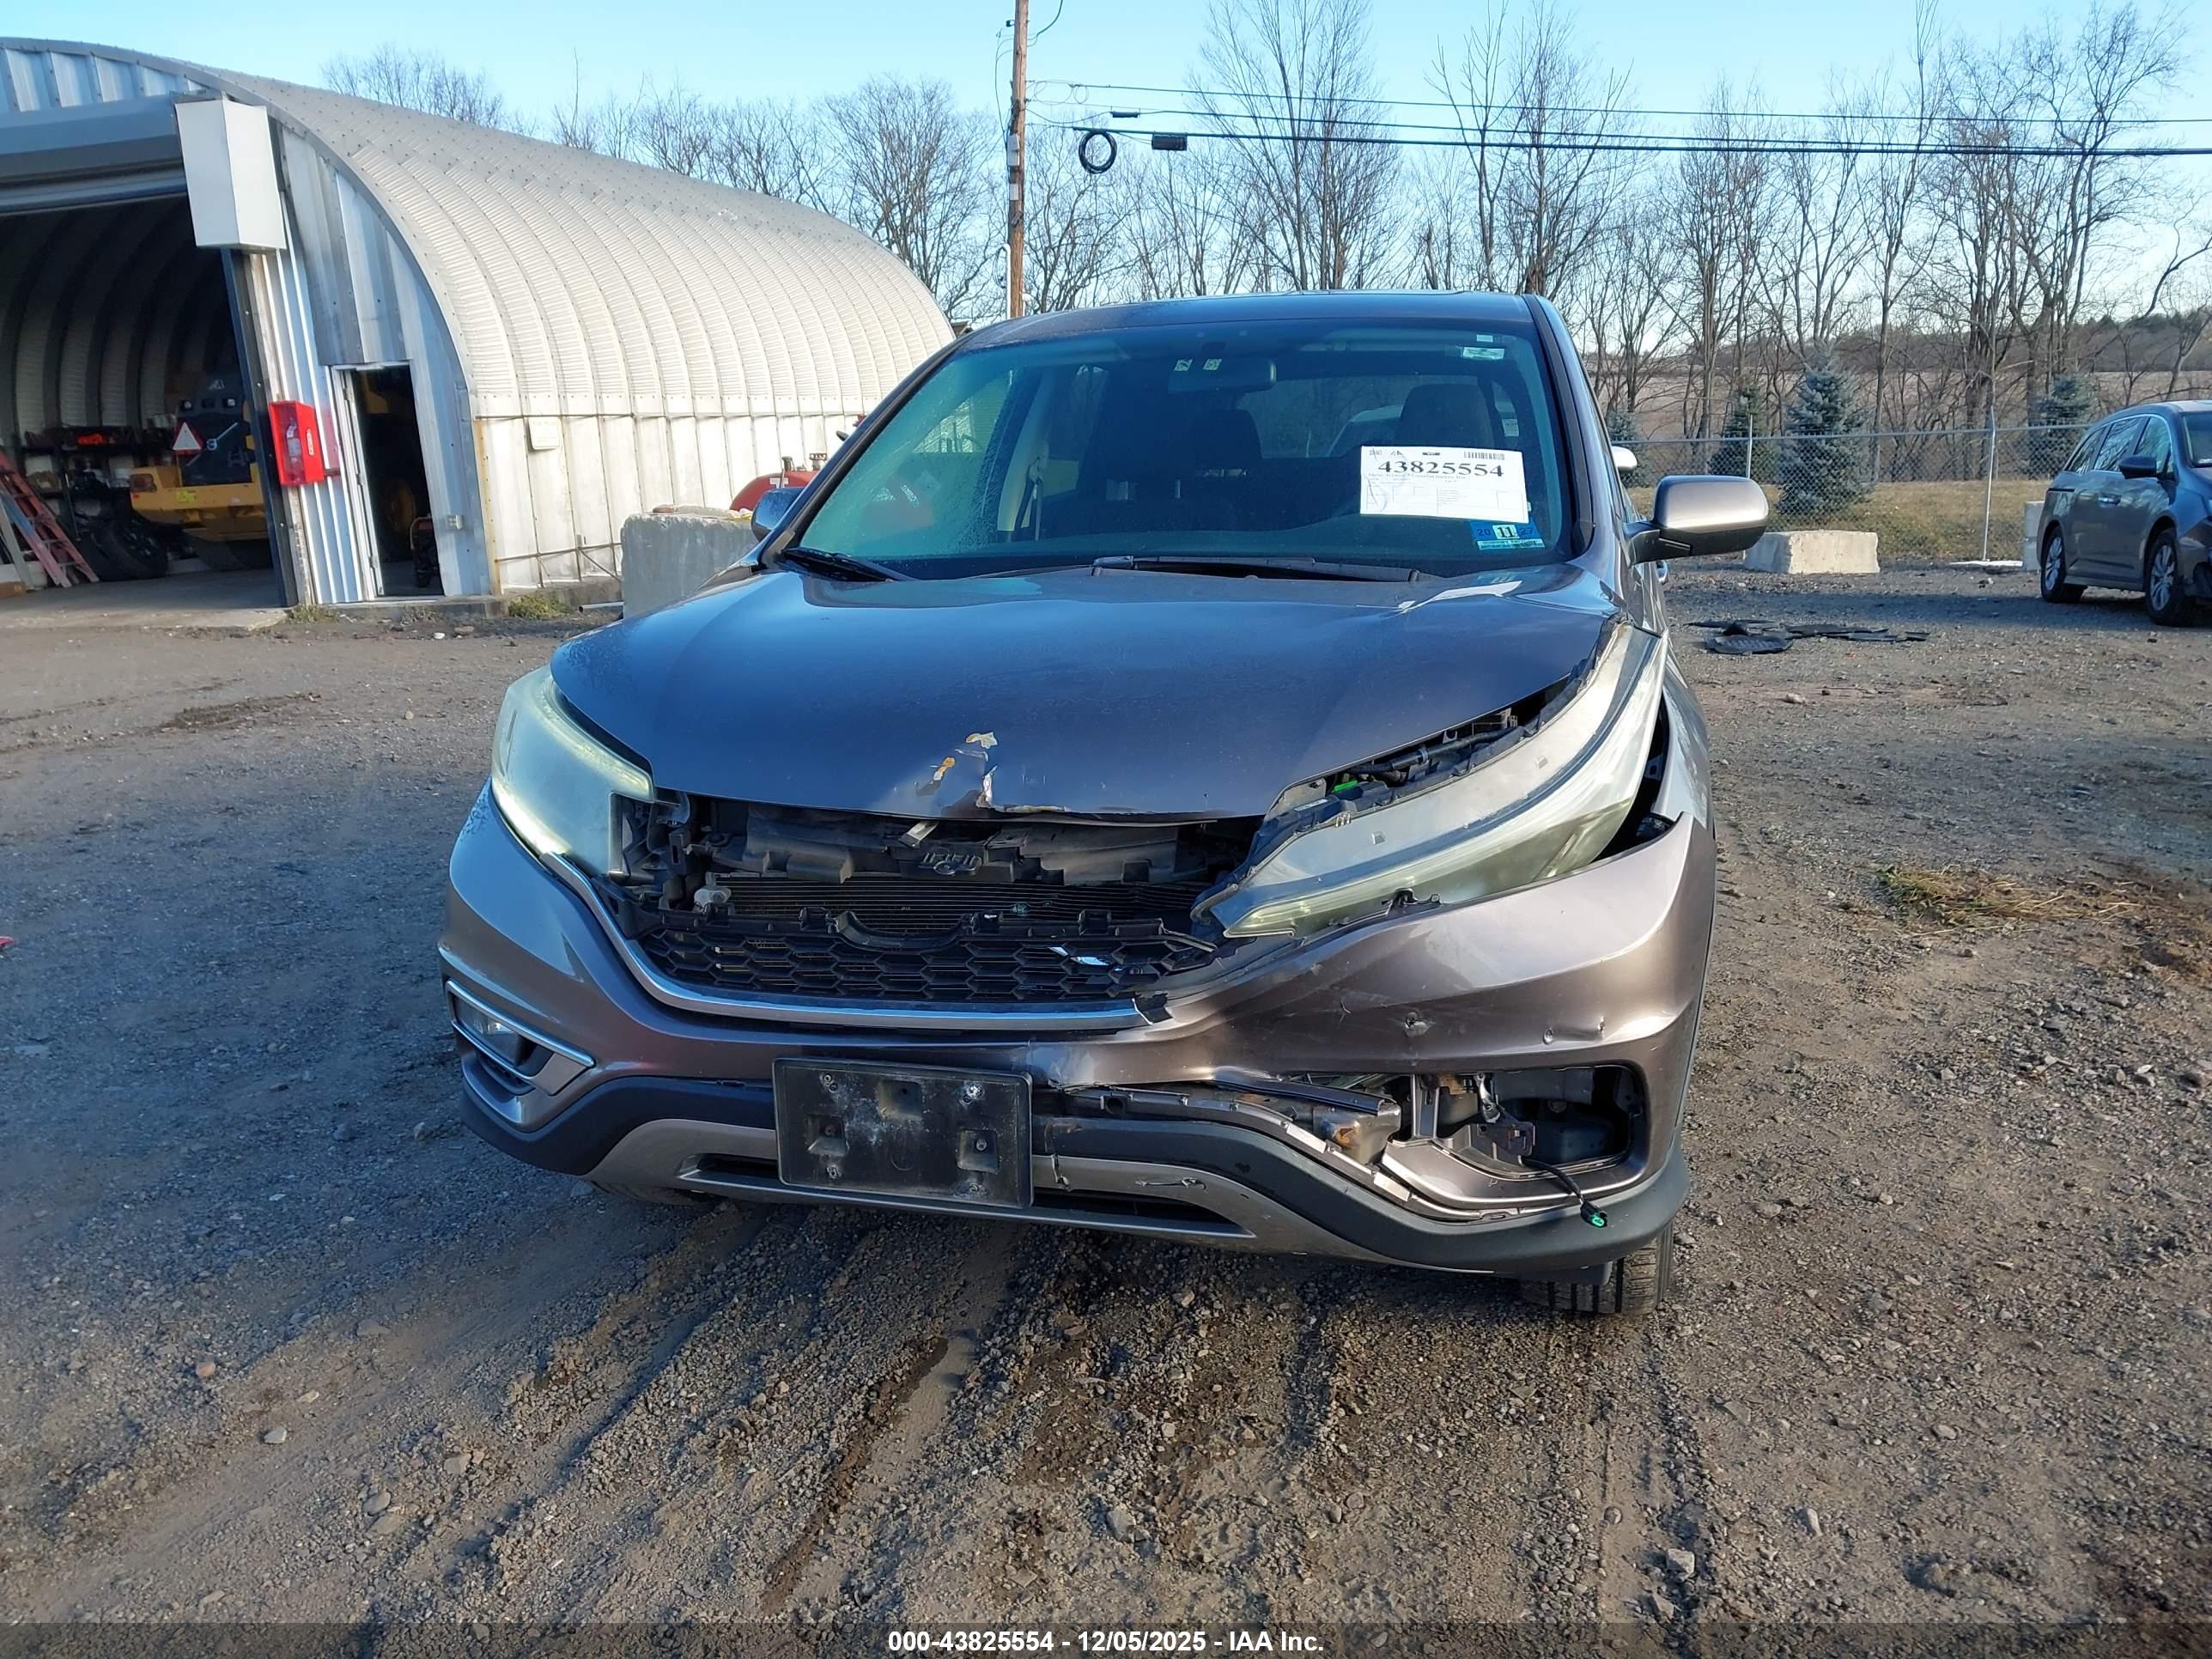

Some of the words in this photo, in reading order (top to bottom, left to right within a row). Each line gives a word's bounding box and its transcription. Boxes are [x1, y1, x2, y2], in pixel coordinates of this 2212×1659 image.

[1378, 461, 1504, 477] 43825554
[1476, 528, 1491, 537] 20
[1498, 526, 1515, 538] 11
